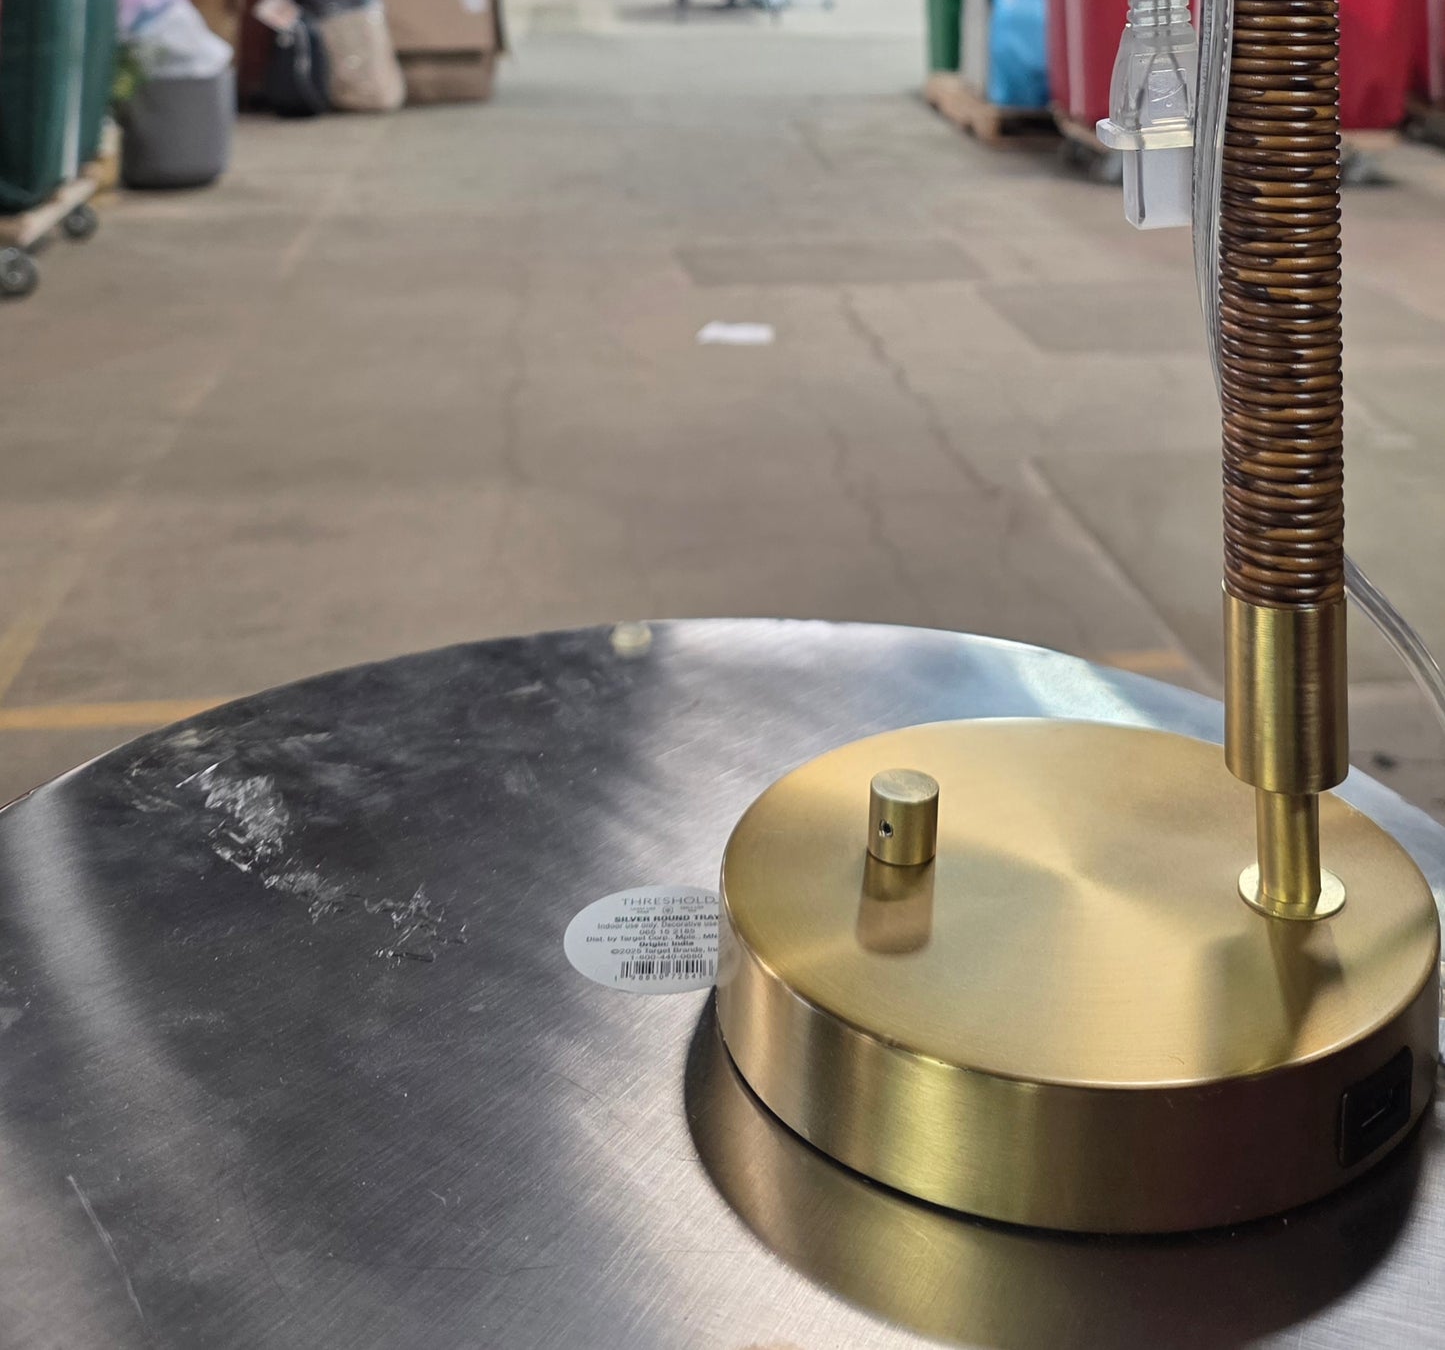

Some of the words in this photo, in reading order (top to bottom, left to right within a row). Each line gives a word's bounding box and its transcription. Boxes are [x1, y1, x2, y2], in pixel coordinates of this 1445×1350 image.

[623, 896, 716, 906] THRESHOLD
[661, 920, 702, 928] Decorative
[620, 934, 646, 943] Target
[672, 939, 694, 947] India
[645, 947, 671, 955] Target
